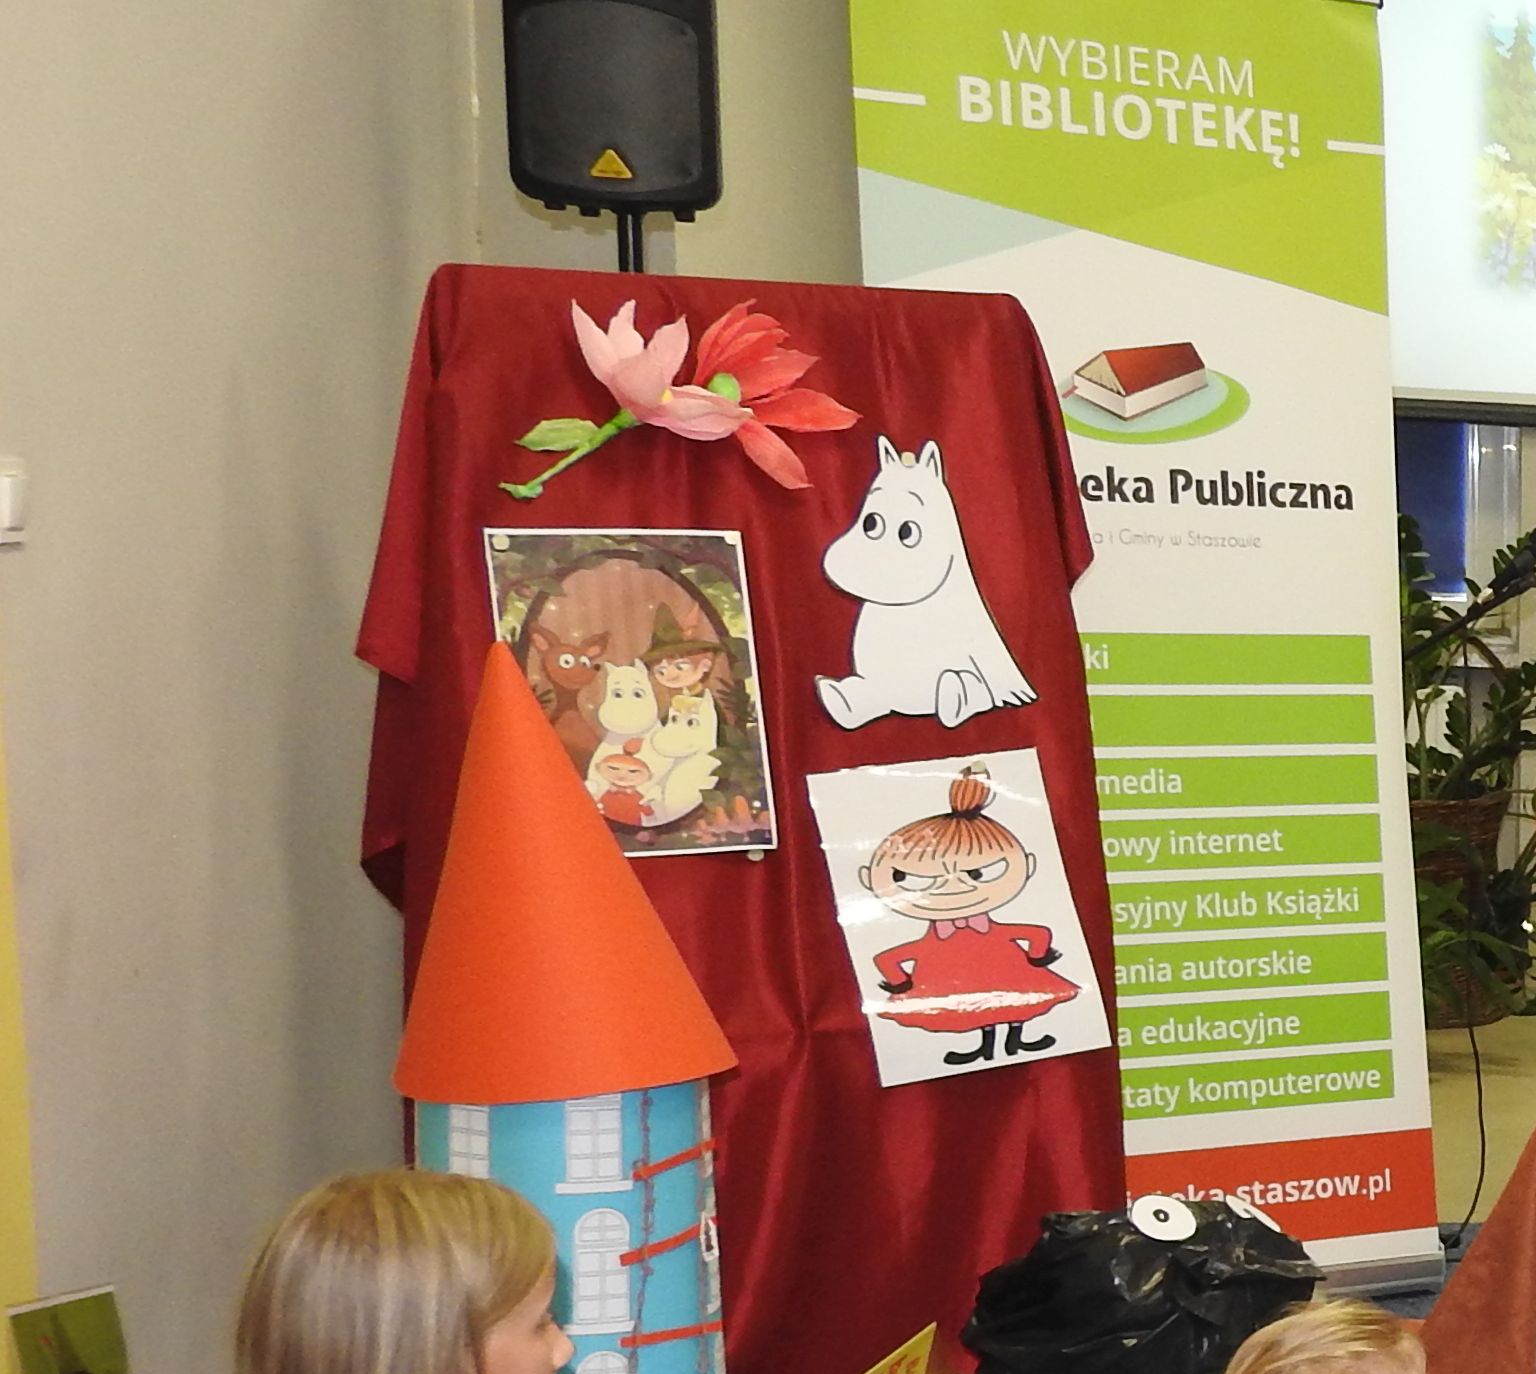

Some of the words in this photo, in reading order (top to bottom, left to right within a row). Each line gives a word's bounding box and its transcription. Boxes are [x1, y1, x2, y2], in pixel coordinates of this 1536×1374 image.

[1001, 28, 1255, 98] WYBIERAM
[957, 75, 1301, 168] BIBLIOTEKĘ!
[1168, 468, 1354, 511] Publiczna
[1118, 528, 1165, 550] Gminy
[1187, 530, 1262, 549] Staszowie
[1169, 828, 1285, 855] internet
[1196, 891, 1258, 918] Klub
[1266, 887, 1360, 920] Książki
[1181, 950, 1313, 982] autorskie
[1141, 1012, 1301, 1045] edukacyjne
[1189, 1069, 1382, 1105] komputerowe
